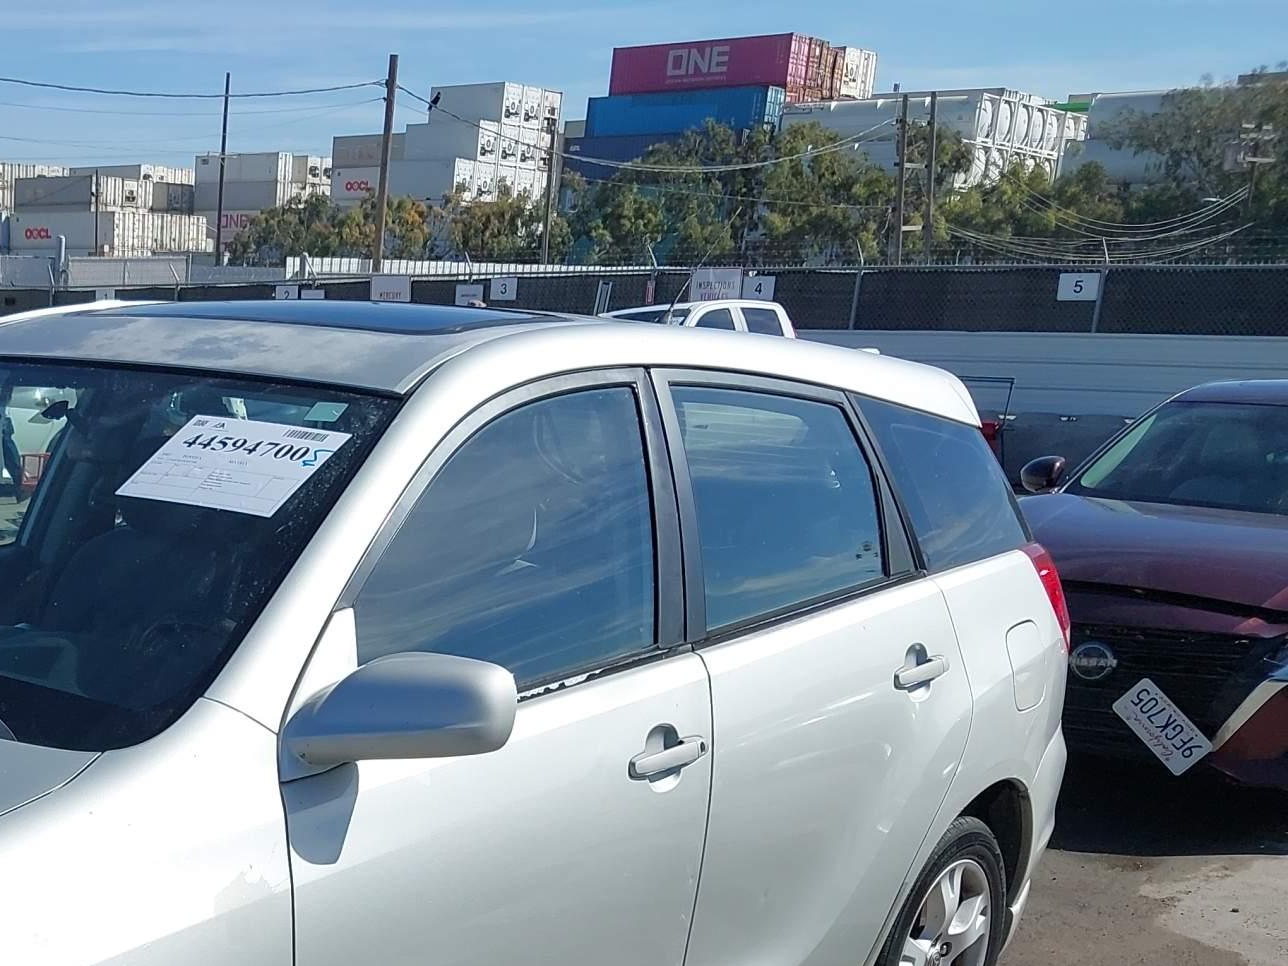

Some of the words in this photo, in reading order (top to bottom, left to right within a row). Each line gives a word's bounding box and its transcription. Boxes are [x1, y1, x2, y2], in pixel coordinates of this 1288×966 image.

[667, 45, 730, 76] ONE
[25, 227, 52, 240] OOCL
[500, 283, 508, 295] 3
[754, 282, 763, 295] 4
[1073, 280, 1084, 294] 5
[182, 433, 310, 462] 44594700
[1130, 688, 1203, 758] 9FGK705
